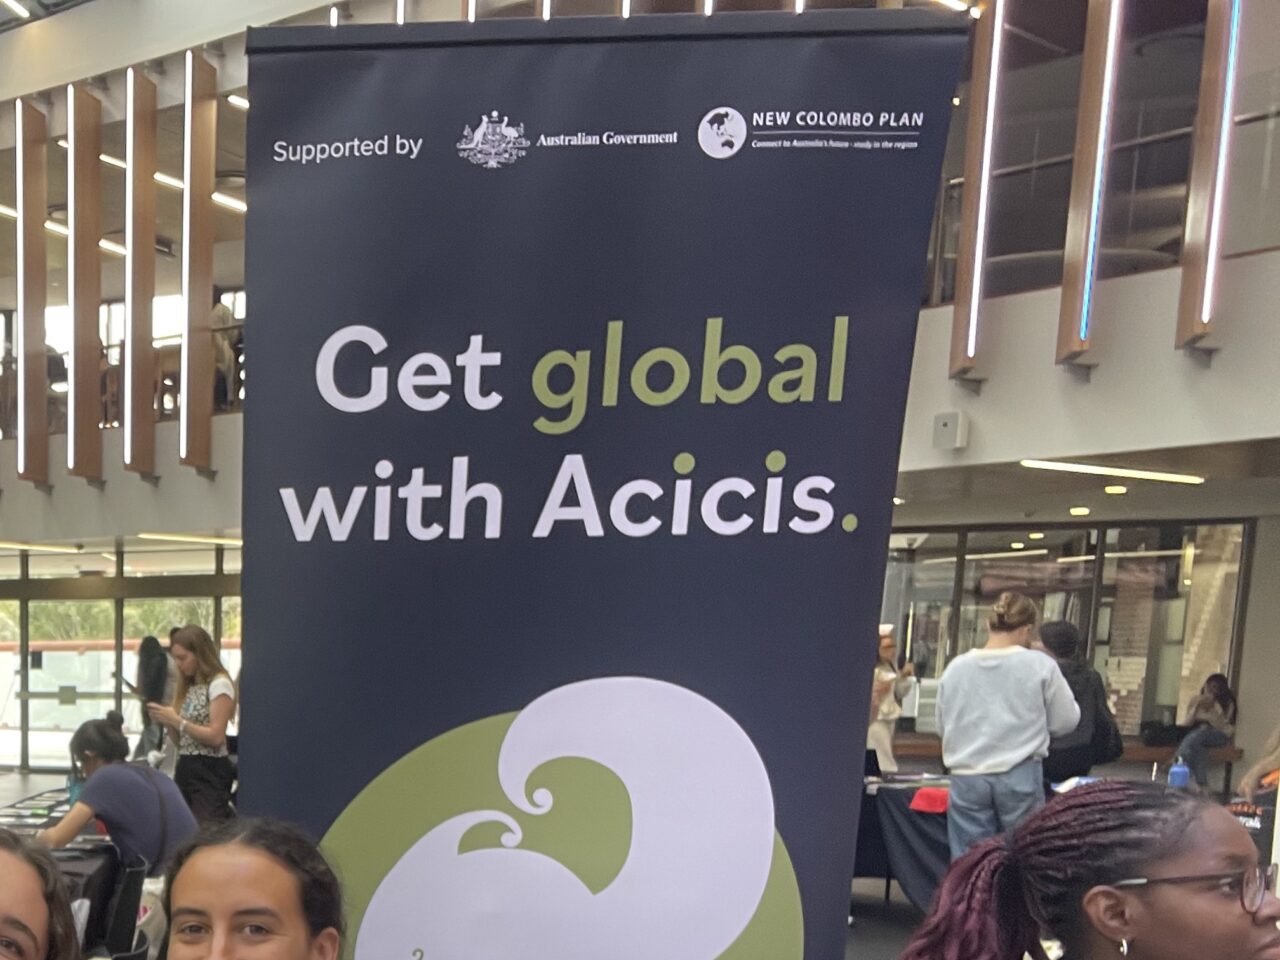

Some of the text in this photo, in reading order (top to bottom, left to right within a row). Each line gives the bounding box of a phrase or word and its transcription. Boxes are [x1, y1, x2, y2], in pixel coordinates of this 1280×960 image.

[752, 112, 924, 127] NEW COLOMBO PLAN
[272, 134, 423, 164] Supported by
[535, 130, 678, 147] Australian Government
[752, 139, 782, 148] Connect
[881, 140, 893, 149] the
[315, 315, 849, 435] Get global
[279, 450, 858, 542] with Acicis.
